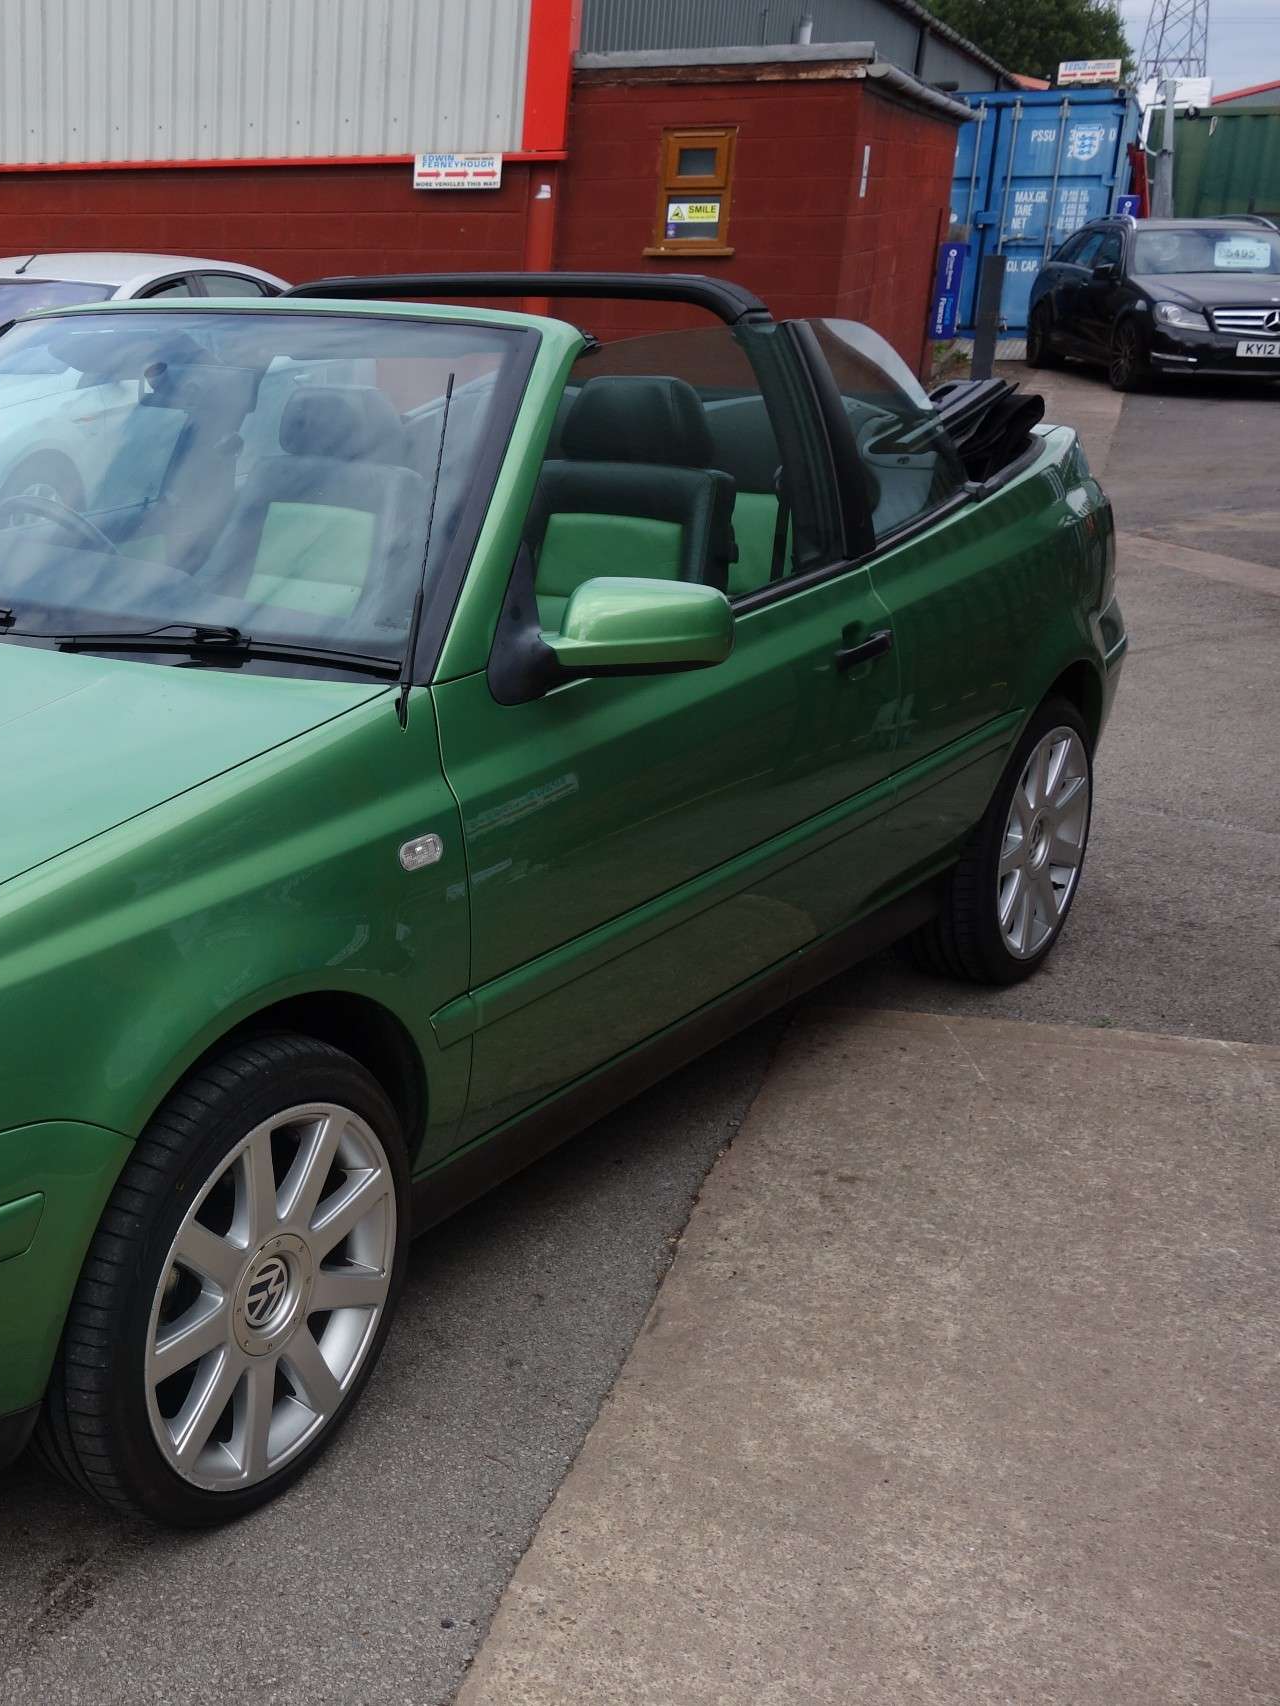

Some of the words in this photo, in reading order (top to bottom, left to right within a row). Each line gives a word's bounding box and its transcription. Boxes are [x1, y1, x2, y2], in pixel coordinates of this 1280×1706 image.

[1031, 129, 1056, 142] PSSU
[688, 204, 716, 213] SMILE
[1014, 204, 1033, 216] TARE
[1011, 217, 1027, 230] NET
[1246, 343, 1275, 355] KY12
